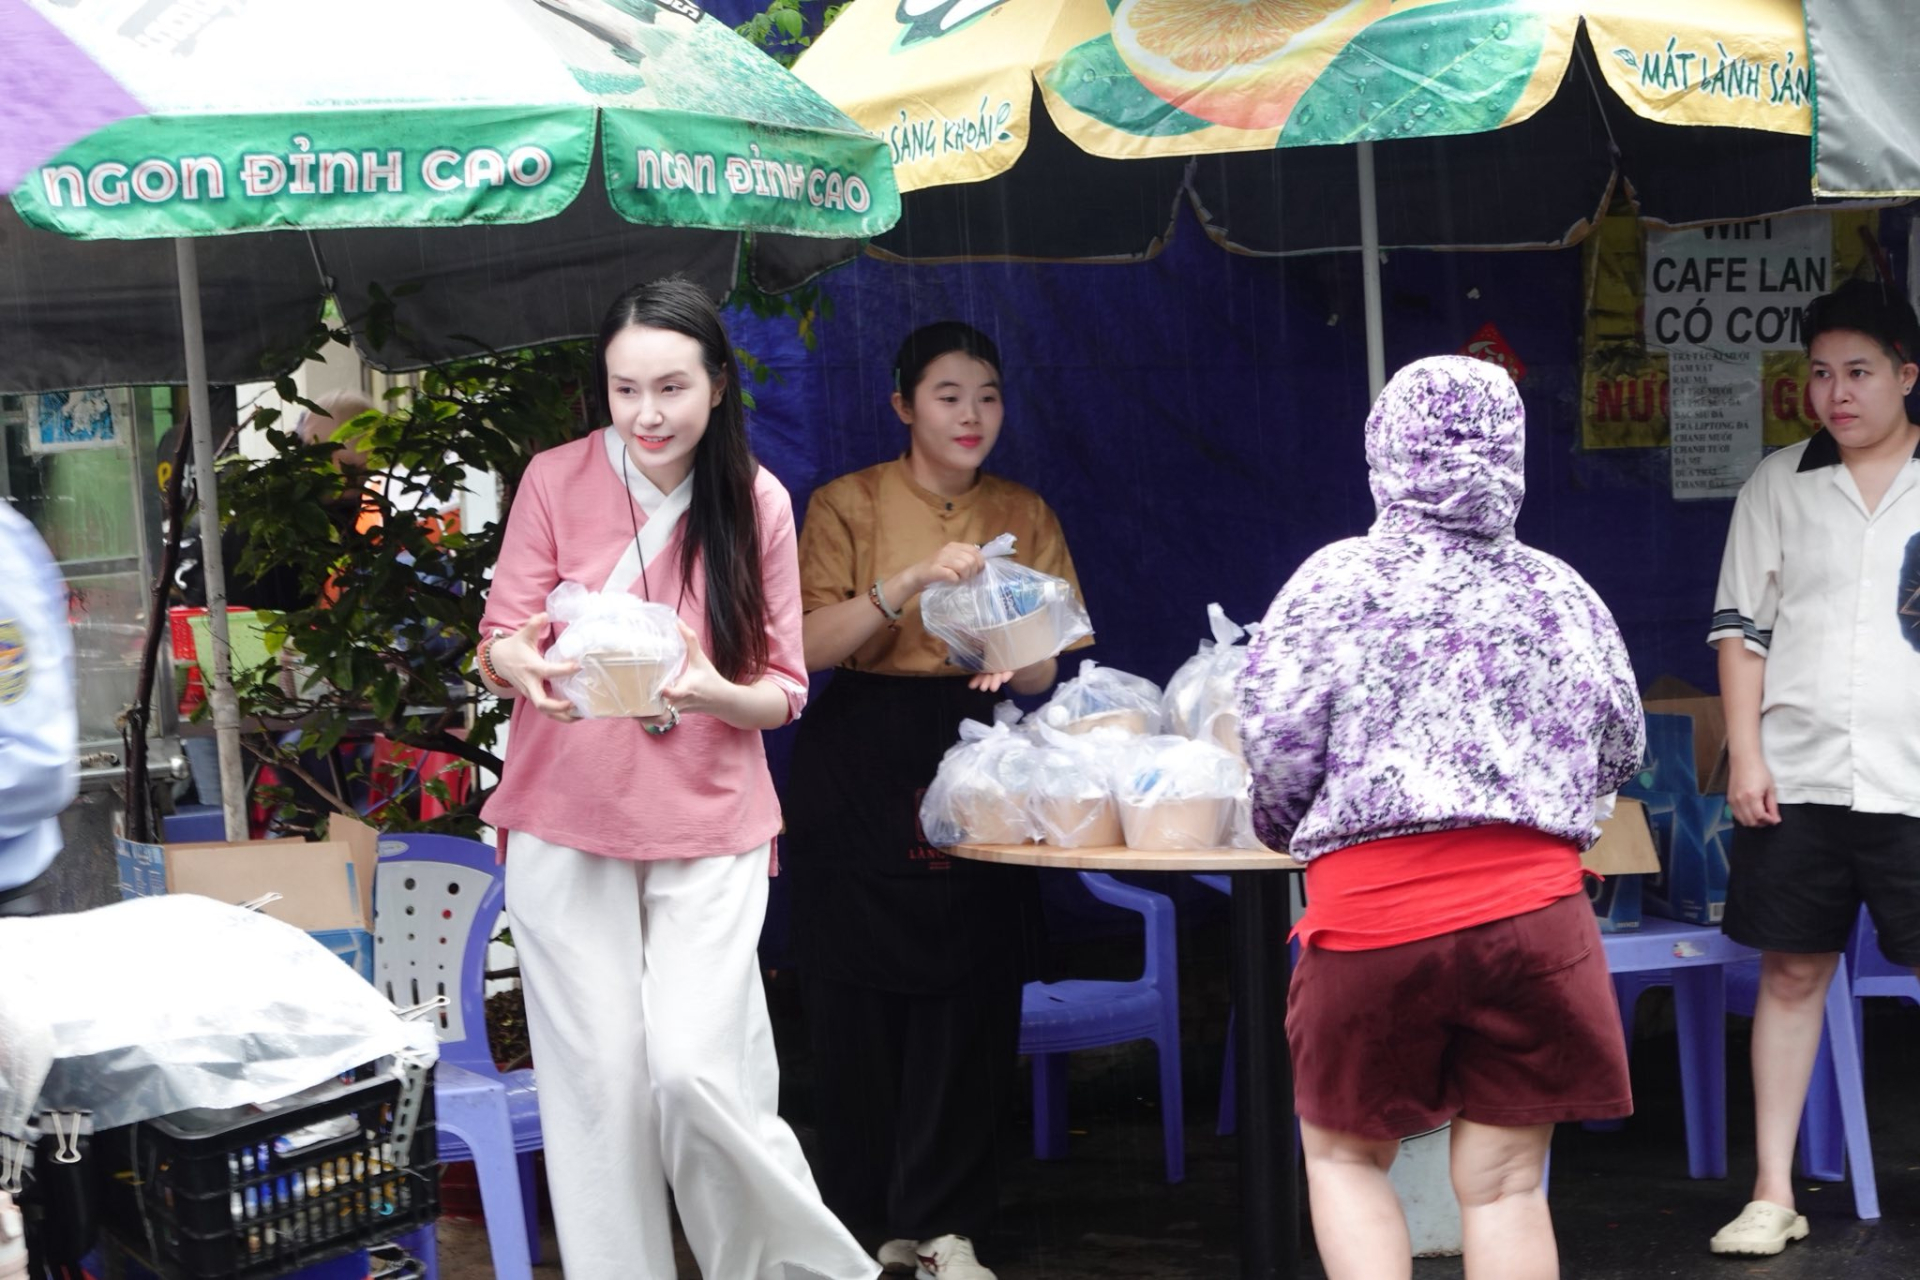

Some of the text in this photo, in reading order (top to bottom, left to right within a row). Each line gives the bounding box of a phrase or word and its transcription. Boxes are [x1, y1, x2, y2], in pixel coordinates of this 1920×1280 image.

[1641, 36, 1812, 106] MÁT LÀNH SẢN
[891, 95, 993, 165] SẢNG KHOÁI
[41, 135, 553, 207] NGON ĐỈNH CAO
[637, 143, 871, 214] NGON ĐỈNH CAO
[1653, 256, 1826, 294] CAFE LAN
[1655, 298, 1714, 345] CÓ
[1674, 433, 1706, 442] CHANH
[1674, 445, 1706, 454] CHANH
